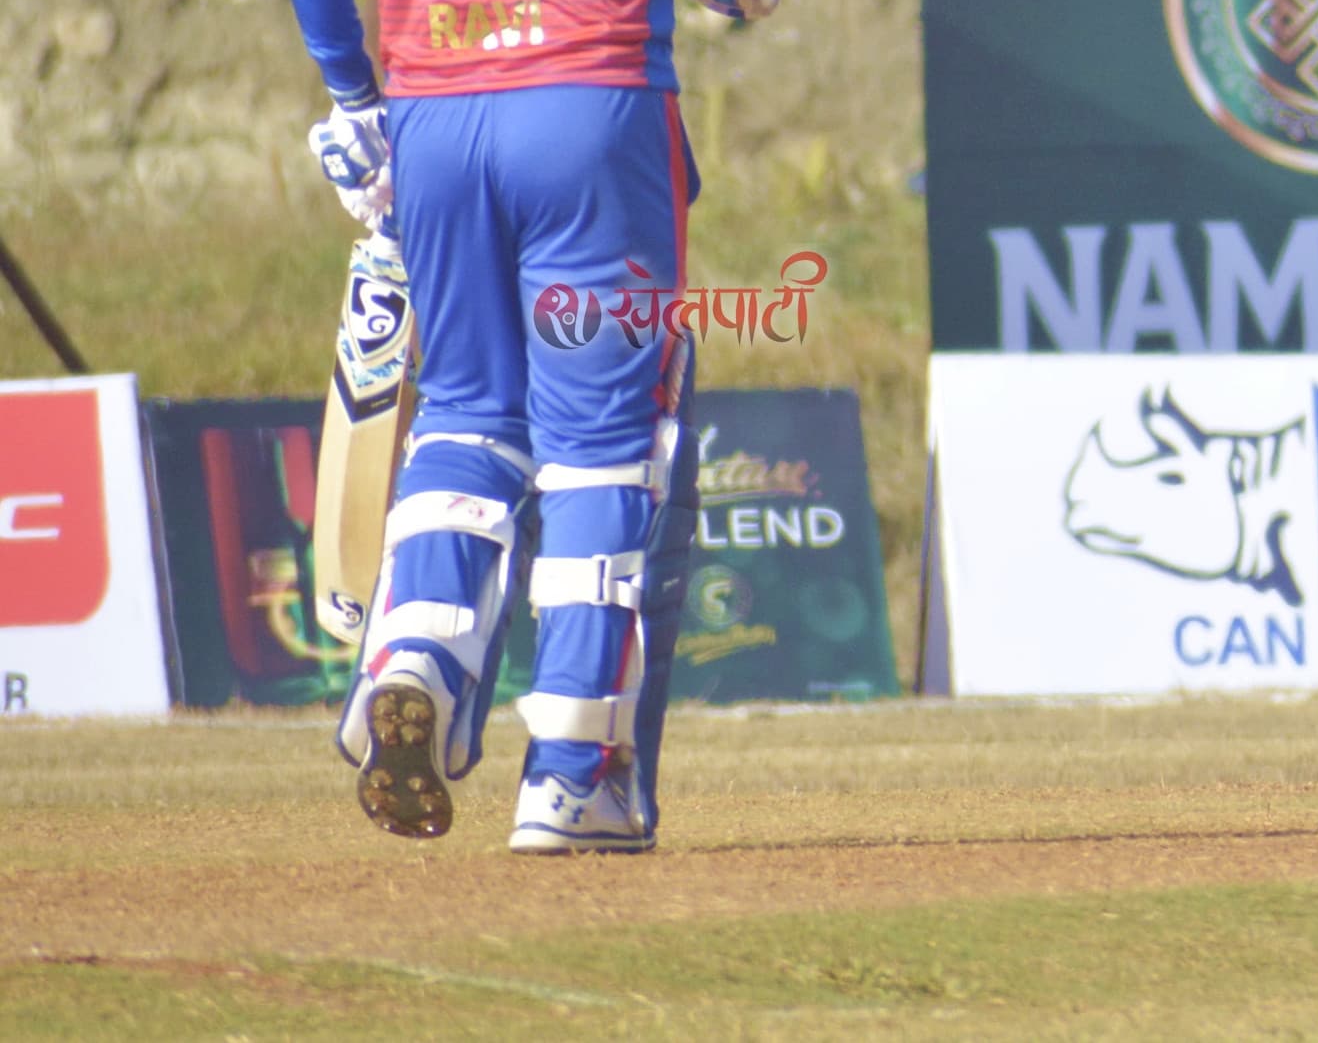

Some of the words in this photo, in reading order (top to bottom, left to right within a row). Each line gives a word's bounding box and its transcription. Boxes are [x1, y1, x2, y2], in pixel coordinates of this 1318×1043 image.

[428, 0, 545, 50] RAVI
[692, 506, 844, 548] LEND
[1172, 613, 1306, 668] CAN
